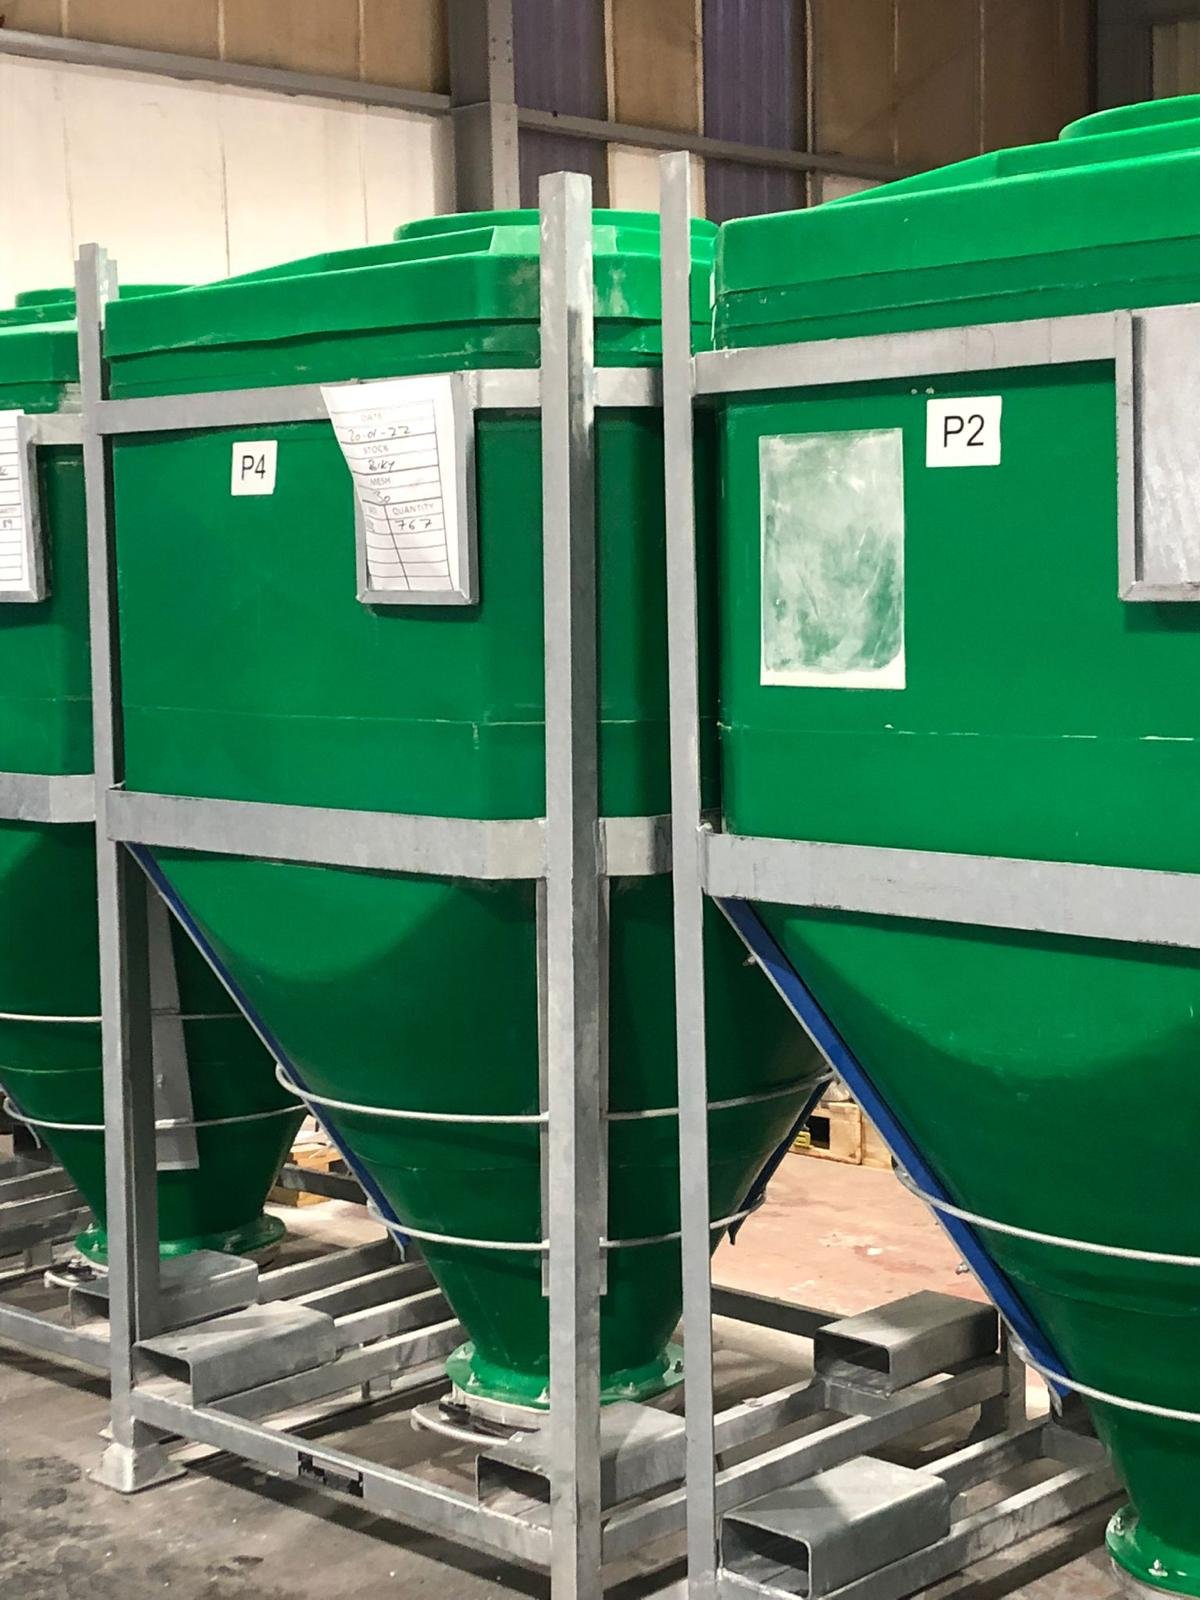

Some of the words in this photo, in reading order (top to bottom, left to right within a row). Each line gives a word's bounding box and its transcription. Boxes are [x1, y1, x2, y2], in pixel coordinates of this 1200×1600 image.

[943, 414, 984, 448] P2
[363, 444, 389, 455] STOCK
[241, 454, 266, 481] P4
[370, 477, 392, 487] MESH
[392, 502, 435, 516] QUANTITY
